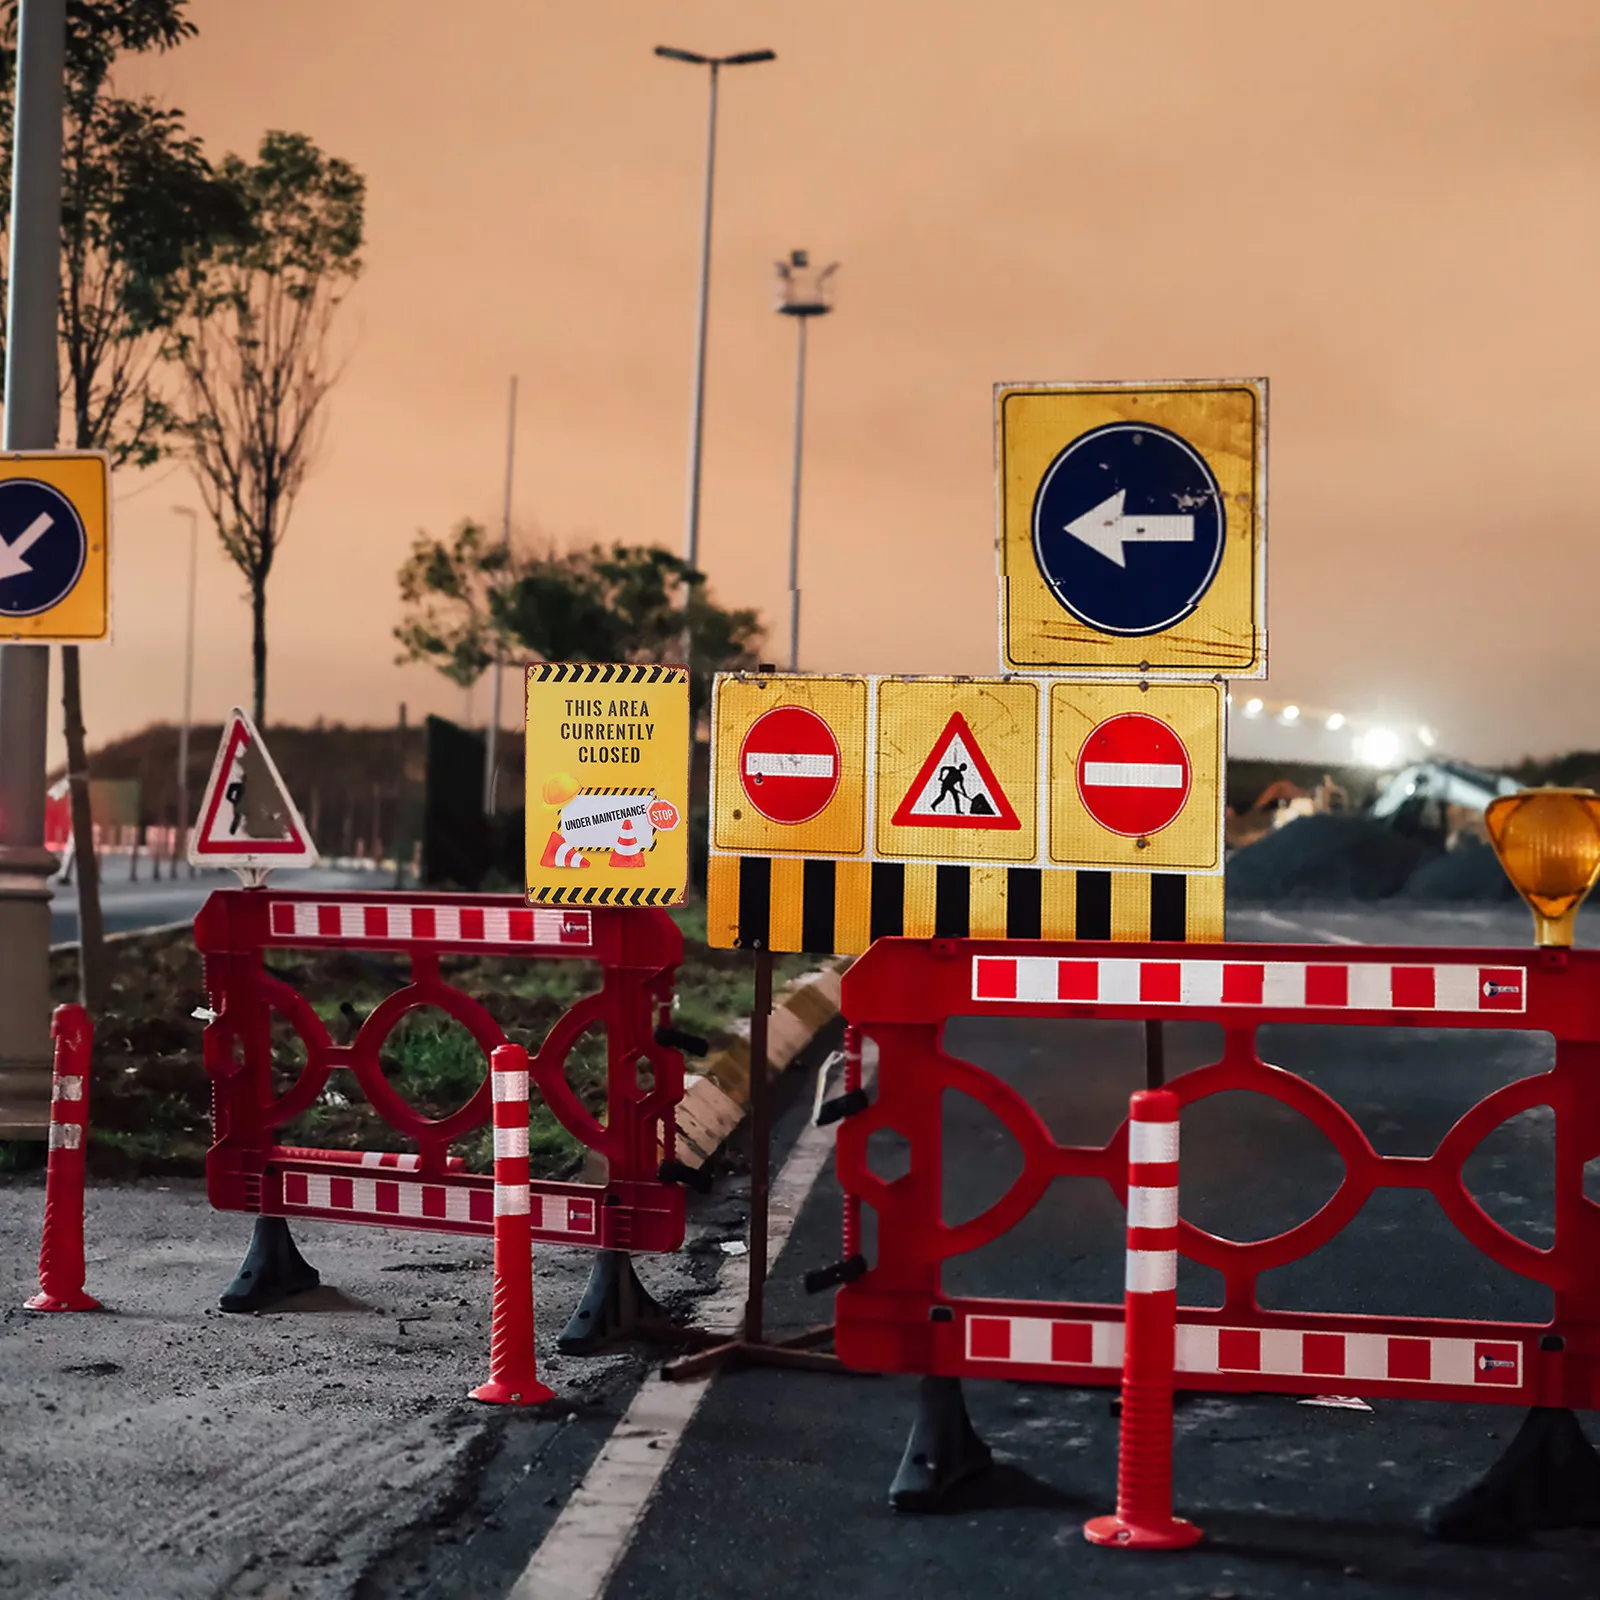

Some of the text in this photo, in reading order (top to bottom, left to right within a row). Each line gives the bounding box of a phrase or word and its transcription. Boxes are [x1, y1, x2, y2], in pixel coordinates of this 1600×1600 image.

[565, 699, 649, 717] THIS AREA
[560, 722, 655, 740] CURRENTLY
[578, 746, 641, 763] CLOSED
[565, 804, 647, 831] UNDER MAINTENANCE
[651, 809, 674, 822] STOP
